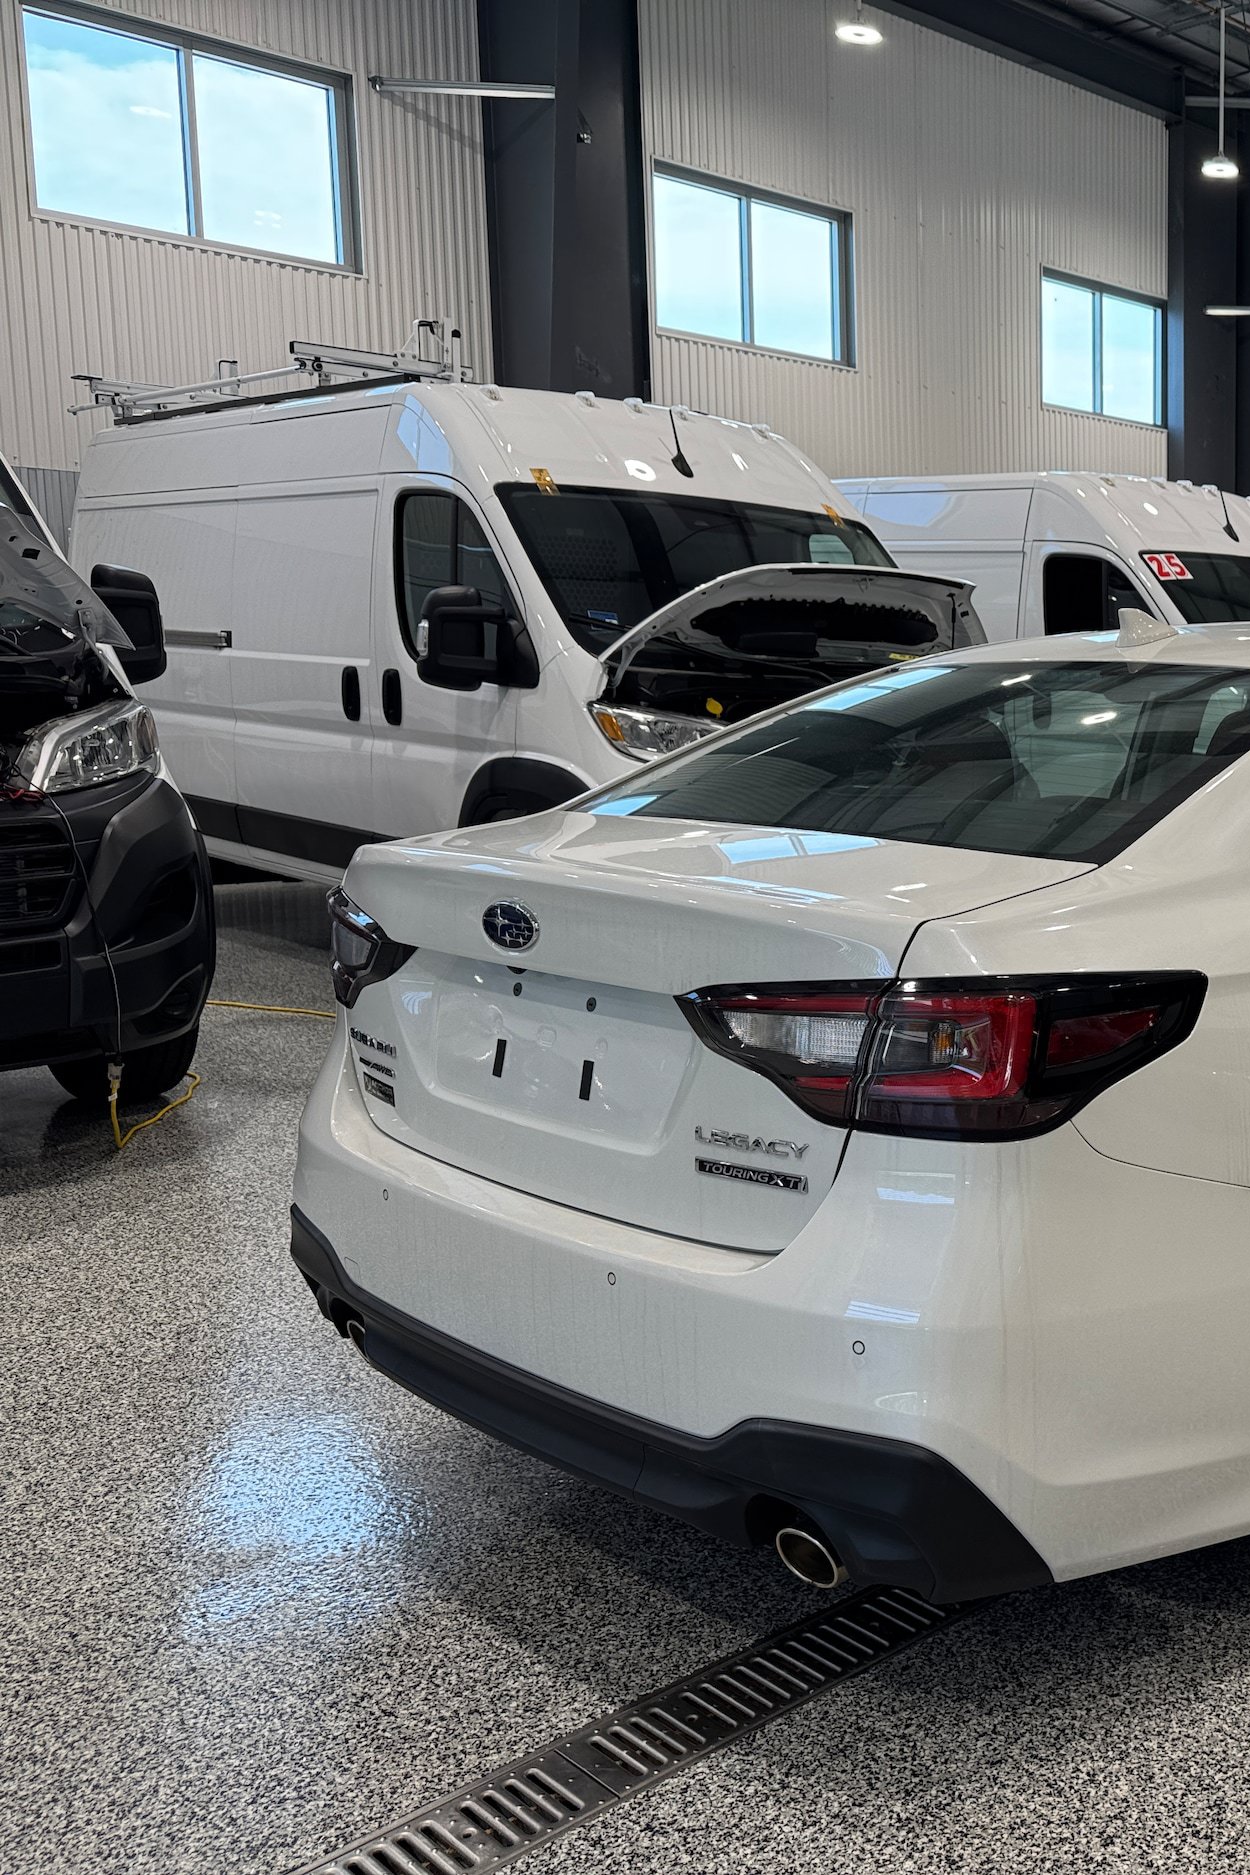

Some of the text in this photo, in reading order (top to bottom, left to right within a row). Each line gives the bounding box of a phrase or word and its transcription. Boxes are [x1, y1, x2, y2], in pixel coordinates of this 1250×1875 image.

[1147, 554, 1186, 577] 25
[694, 1125, 810, 1159] LEGACY
[703, 1162, 770, 1183] TOURING
